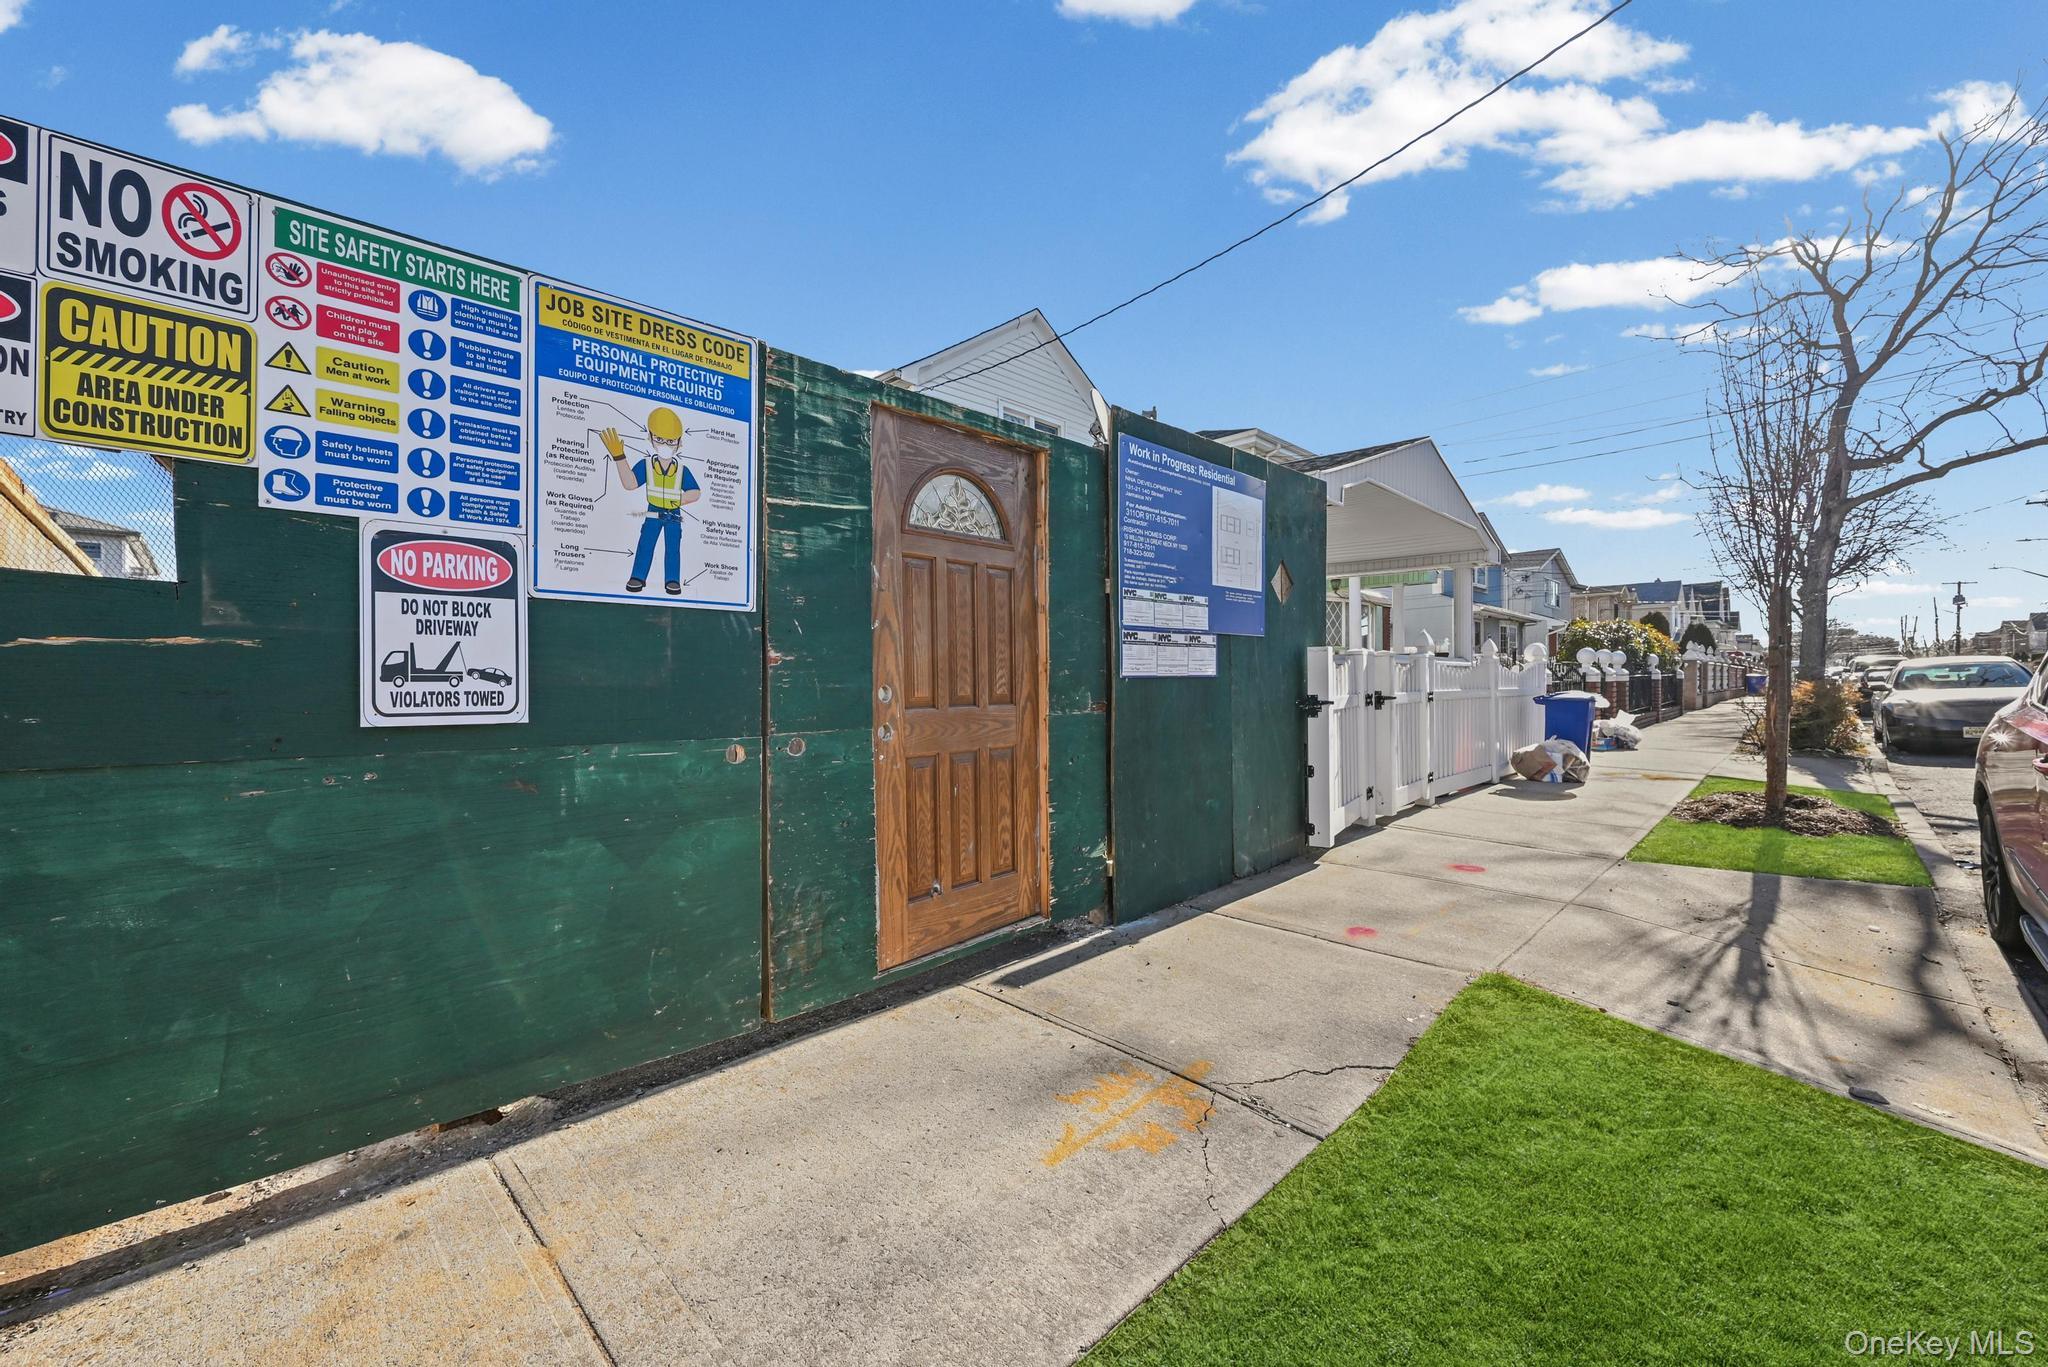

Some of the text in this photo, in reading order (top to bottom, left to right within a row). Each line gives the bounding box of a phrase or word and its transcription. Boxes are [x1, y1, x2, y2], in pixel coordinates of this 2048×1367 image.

[59, 151, 152, 238] NO
[56, 232, 243, 305] SMOKING
[289, 219, 510, 303] SITE SAFETY STARTS HERE
[321, 268, 397, 293] Unauthorised entry
[344, 282, 360, 290] this
[361, 286, 375, 294] site
[324, 285, 394, 306] strictly prohibited
[326, 310, 391, 331] Children must
[454, 311, 487, 324] clothing
[488, 319, 507, 328] must
[461, 304, 513, 322] High visibility
[59, 298, 242, 373] CAUTION
[358, 328, 377, 338] play
[454, 319, 474, 328] worn
[485, 326, 500, 334] this
[501, 331, 518, 339] area
[546, 294, 745, 363] JOB SITE DRESS CODE
[348, 334, 365, 343] this
[368, 338, 384, 346] site
[458, 341, 514, 359] Rubbish chute
[594, 327, 603, 335] DE
[606, 330, 650, 348] VESTIMENTA
[672, 349, 694, 360] LUGAR
[695, 355, 704, 363] DE
[705, 357, 733, 370] TRABAJO
[332, 357, 384, 375] Caution
[486, 364, 508, 374] times
[488, 358, 507, 366] used
[573, 338, 724, 388] PERSONAL PROTECTIVE
[326, 366, 391, 386] Men at work
[575, 354, 723, 401] EQUIPMENT REQUIRED
[76, 373, 224, 419] AREA UNDER
[454, 389, 518, 405] visitors must report
[473, 385, 496, 394] drivers
[558, 368, 735, 415] EQUIPO DE PROTECCIÓN PERSONAL ES OBLIGATORIO
[564, 391, 578, 400] Eye
[331, 397, 385, 417] Warning
[551, 396, 590, 409] Protection
[319, 406, 397, 426] Falling objects
[53, 399, 243, 449] CONSTRUCTION
[453, 419, 491, 430] Permission
[458, 434, 486, 444] entering
[460, 428, 511, 441] obtained before
[711, 428, 725, 436] Hard
[322, 440, 393, 457] Safety helmets
[557, 437, 585, 448] Hearing
[325, 451, 350, 460] must
[367, 457, 391, 465] worn
[546, 451, 595, 465] (as Required)
[551, 445, 590, 456] Protection
[455, 455, 515, 469] Personal protection
[706, 459, 739, 470] Appropriate
[1129, 442, 1151, 460] Work
[1152, 450, 1160, 463] in
[1162, 453, 1197, 475] Progress:
[1198, 465, 1236, 486] Residential
[708, 466, 737, 476] Respirator
[333, 479, 384, 492] Protective
[324, 496, 349, 505] must
[336, 488, 380, 499] footwear
[547, 490, 593, 503] Work Gloves
[559, 500, 594, 511] Required)
[717, 522, 741, 531] Visibility
[553, 550, 585, 559] Trousers
[560, 543, 579, 551] Long
[390, 549, 498, 582] NO PARKING
[1124, 589, 1137, 597] NYC
[401, 598, 492, 618] DO NOT BLOCK
[416, 619, 479, 636] DRIVEWAY
[1123, 632, 1138, 640] NYC
[390, 690, 505, 708] VIOLATORS TOWED
